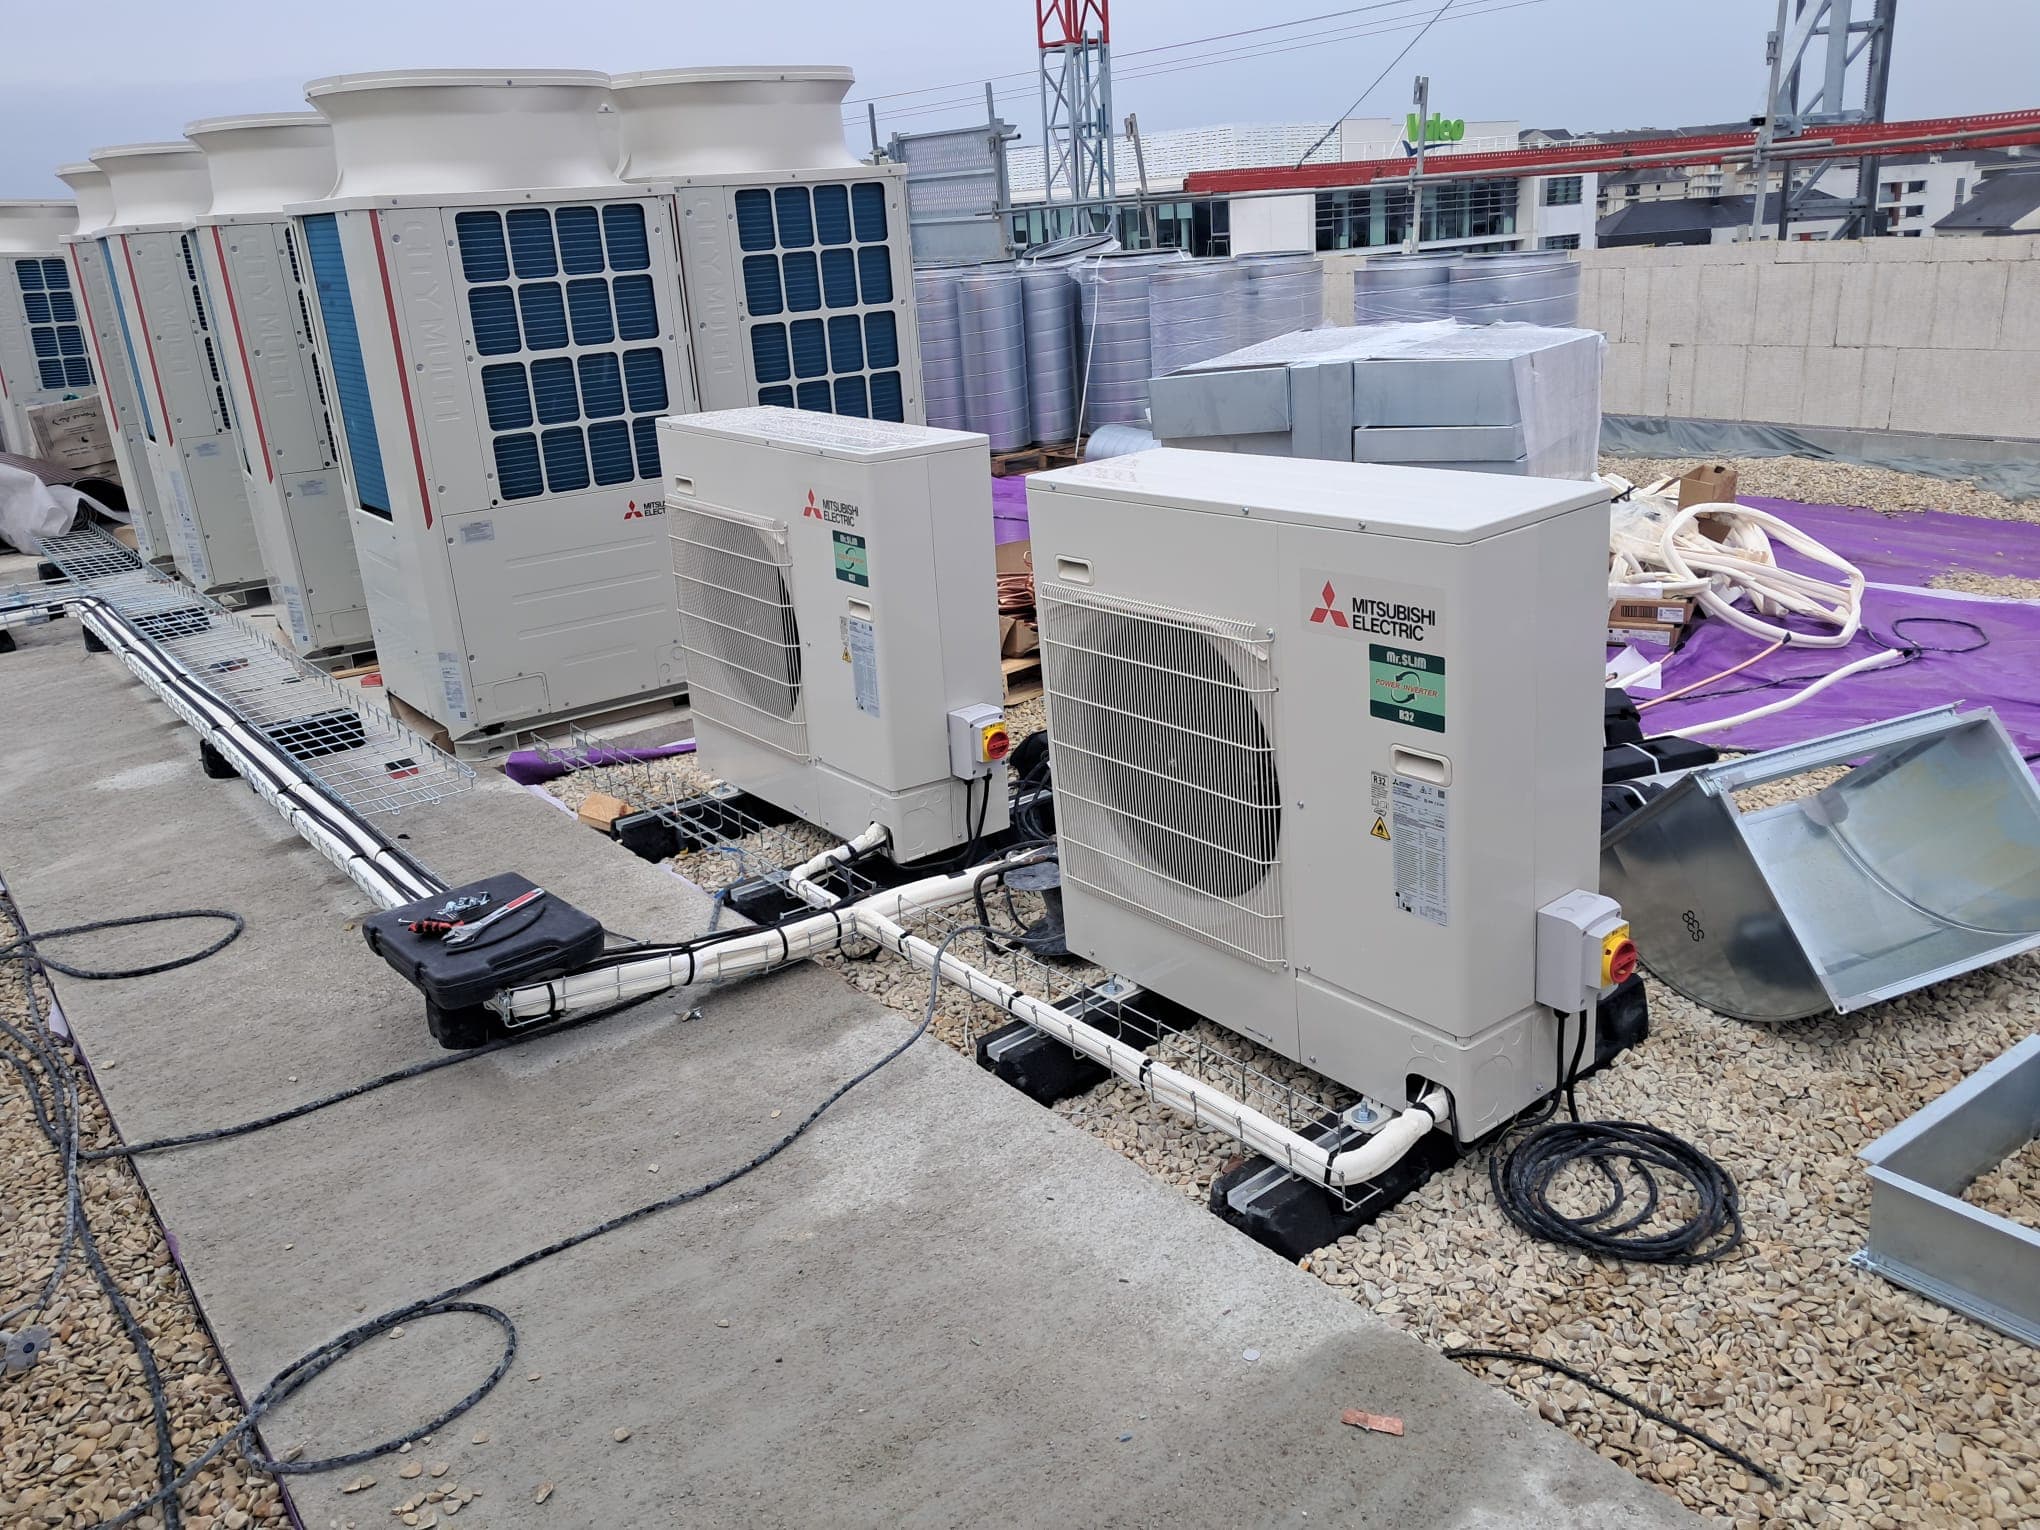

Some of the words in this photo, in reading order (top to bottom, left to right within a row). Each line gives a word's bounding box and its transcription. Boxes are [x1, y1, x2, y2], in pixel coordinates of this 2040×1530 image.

[822, 499, 859, 517] MITSUBISHI
[823, 510, 855, 527] ELECTRIC
[1352, 597, 1435, 626] MITSUBISHI
[1352, 615, 1424, 641] ELECTRIC
[1375, 678, 1401, 690] POWER
[1403, 684, 1439, 698] INVERTER
